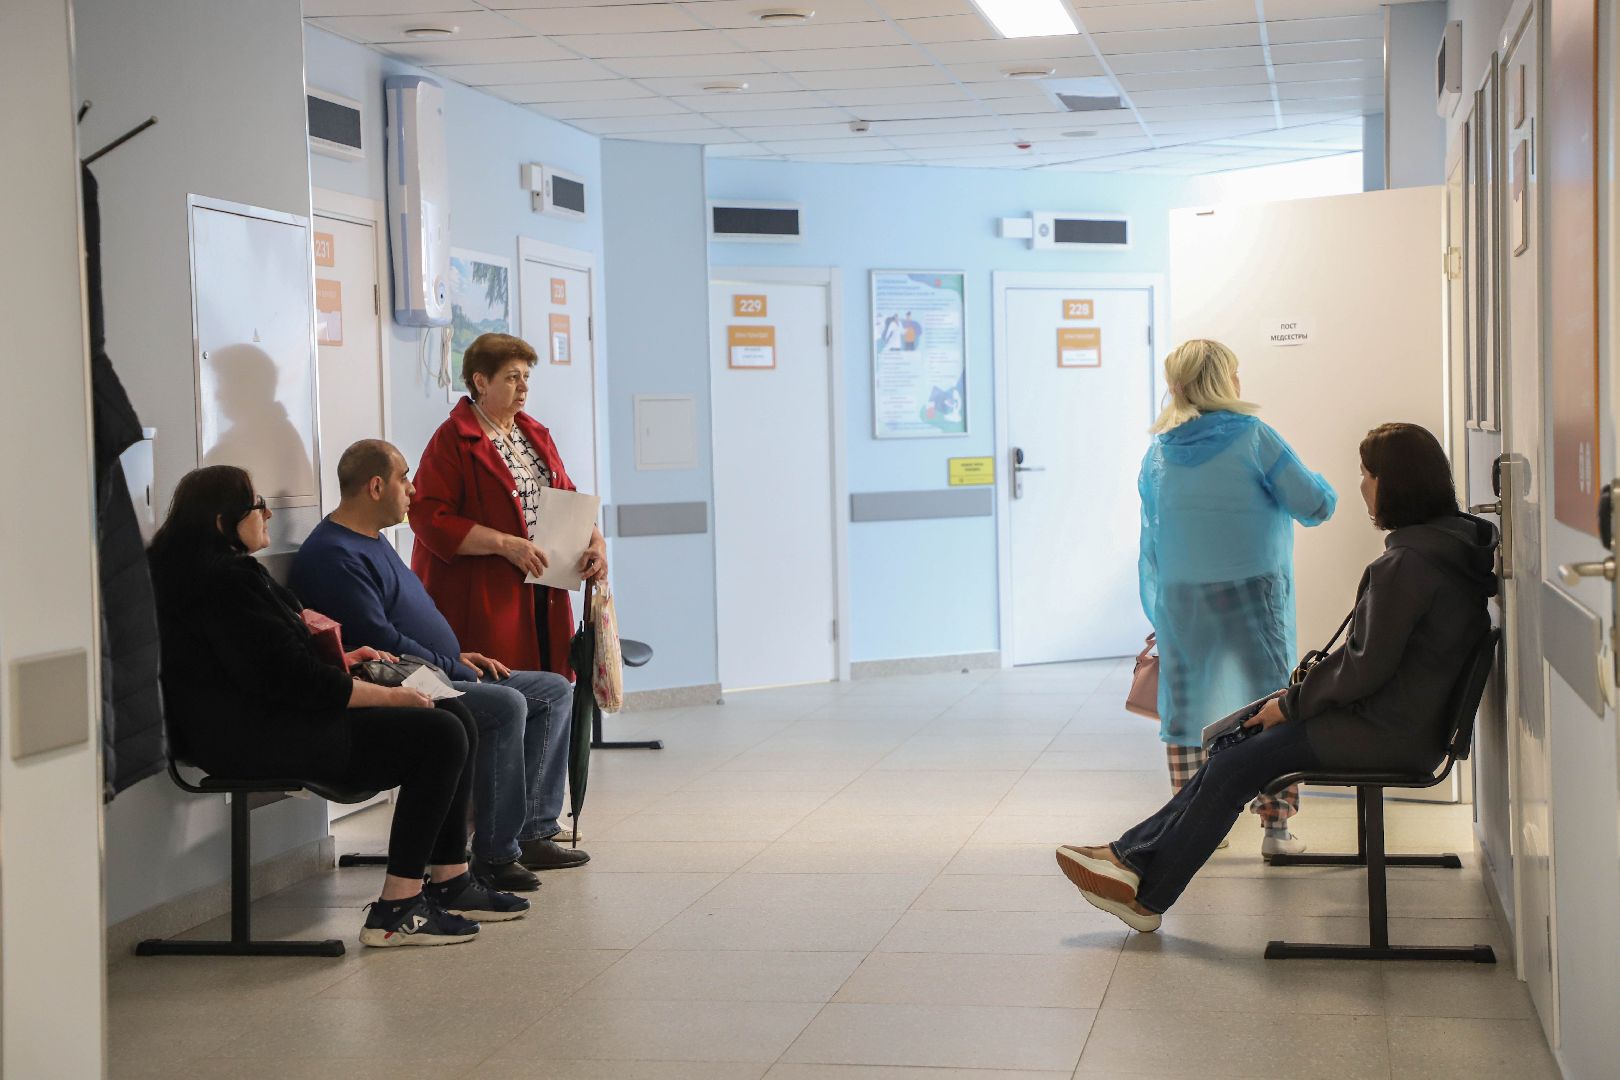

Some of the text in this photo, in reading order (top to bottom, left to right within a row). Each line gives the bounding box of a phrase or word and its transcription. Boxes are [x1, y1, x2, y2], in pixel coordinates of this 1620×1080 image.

[315, 239, 330, 258] 231
[739, 299, 762, 312] 229
[1069, 303, 1089, 315] 228
[1280, 322, 1297, 330] ПОСТ
[1270, 333, 1308, 341] МЕДСЕСТРЫ
